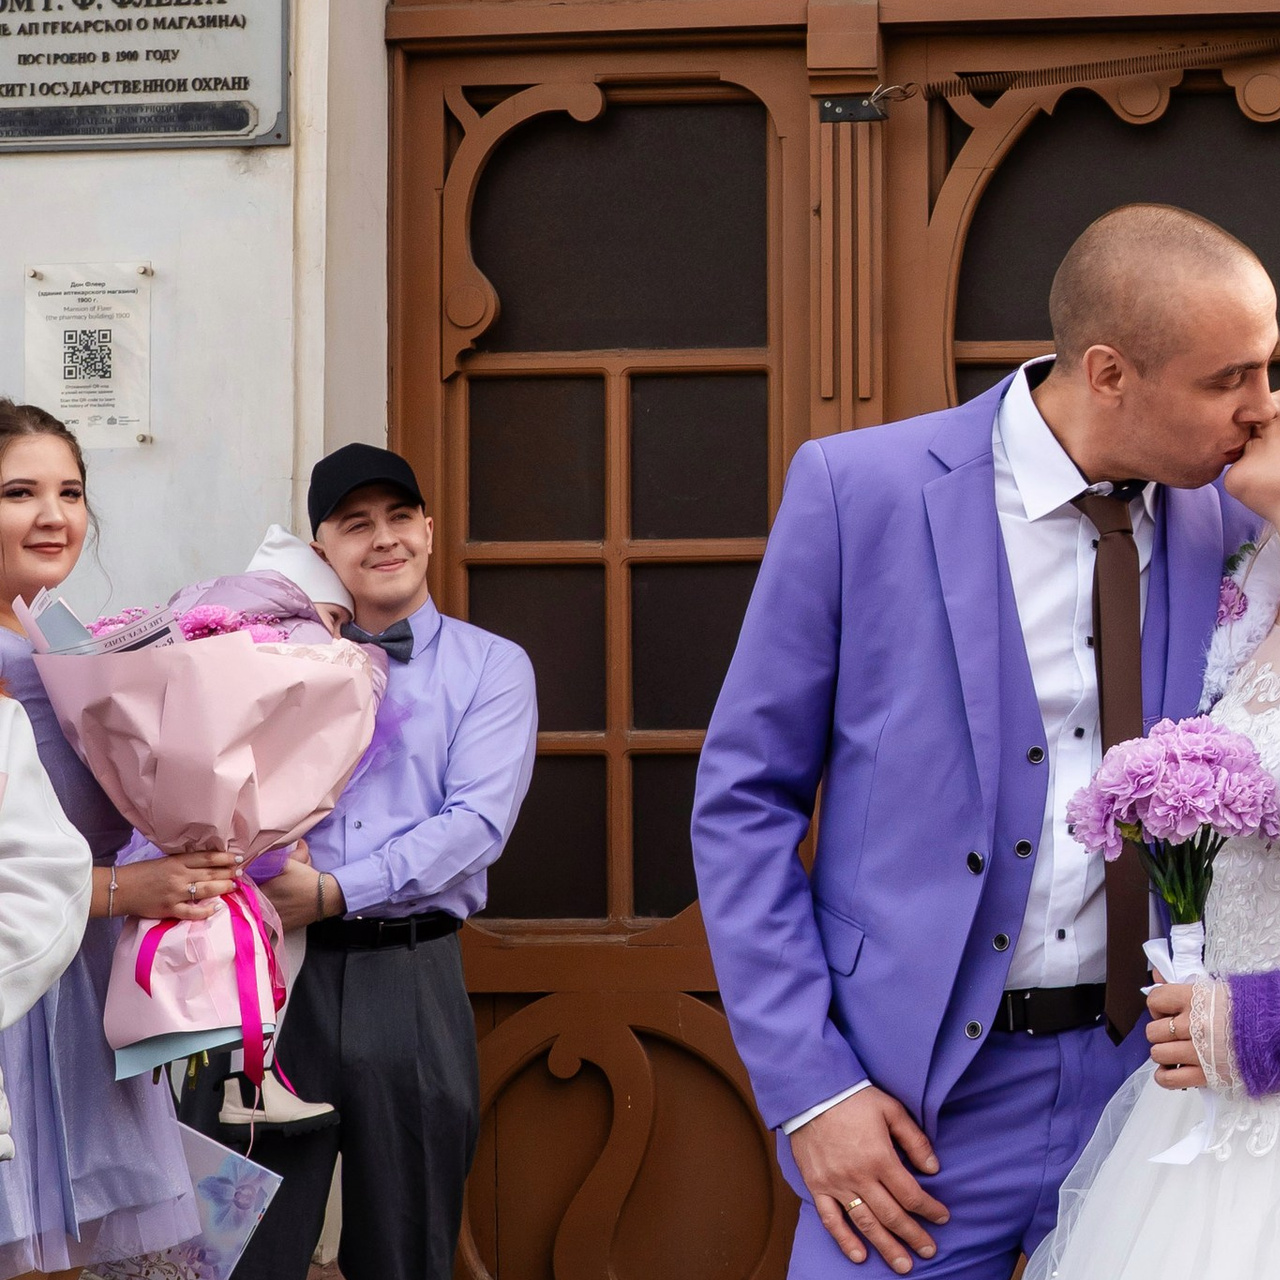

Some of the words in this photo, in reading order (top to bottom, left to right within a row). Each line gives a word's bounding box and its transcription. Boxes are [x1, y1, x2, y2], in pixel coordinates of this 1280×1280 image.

[153, 15, 246, 30] МАГАЗИНА)
[102, 52, 110, 63] В
[116, 51, 139, 62] 1900
[146, 50, 179, 63] ГОДУ
